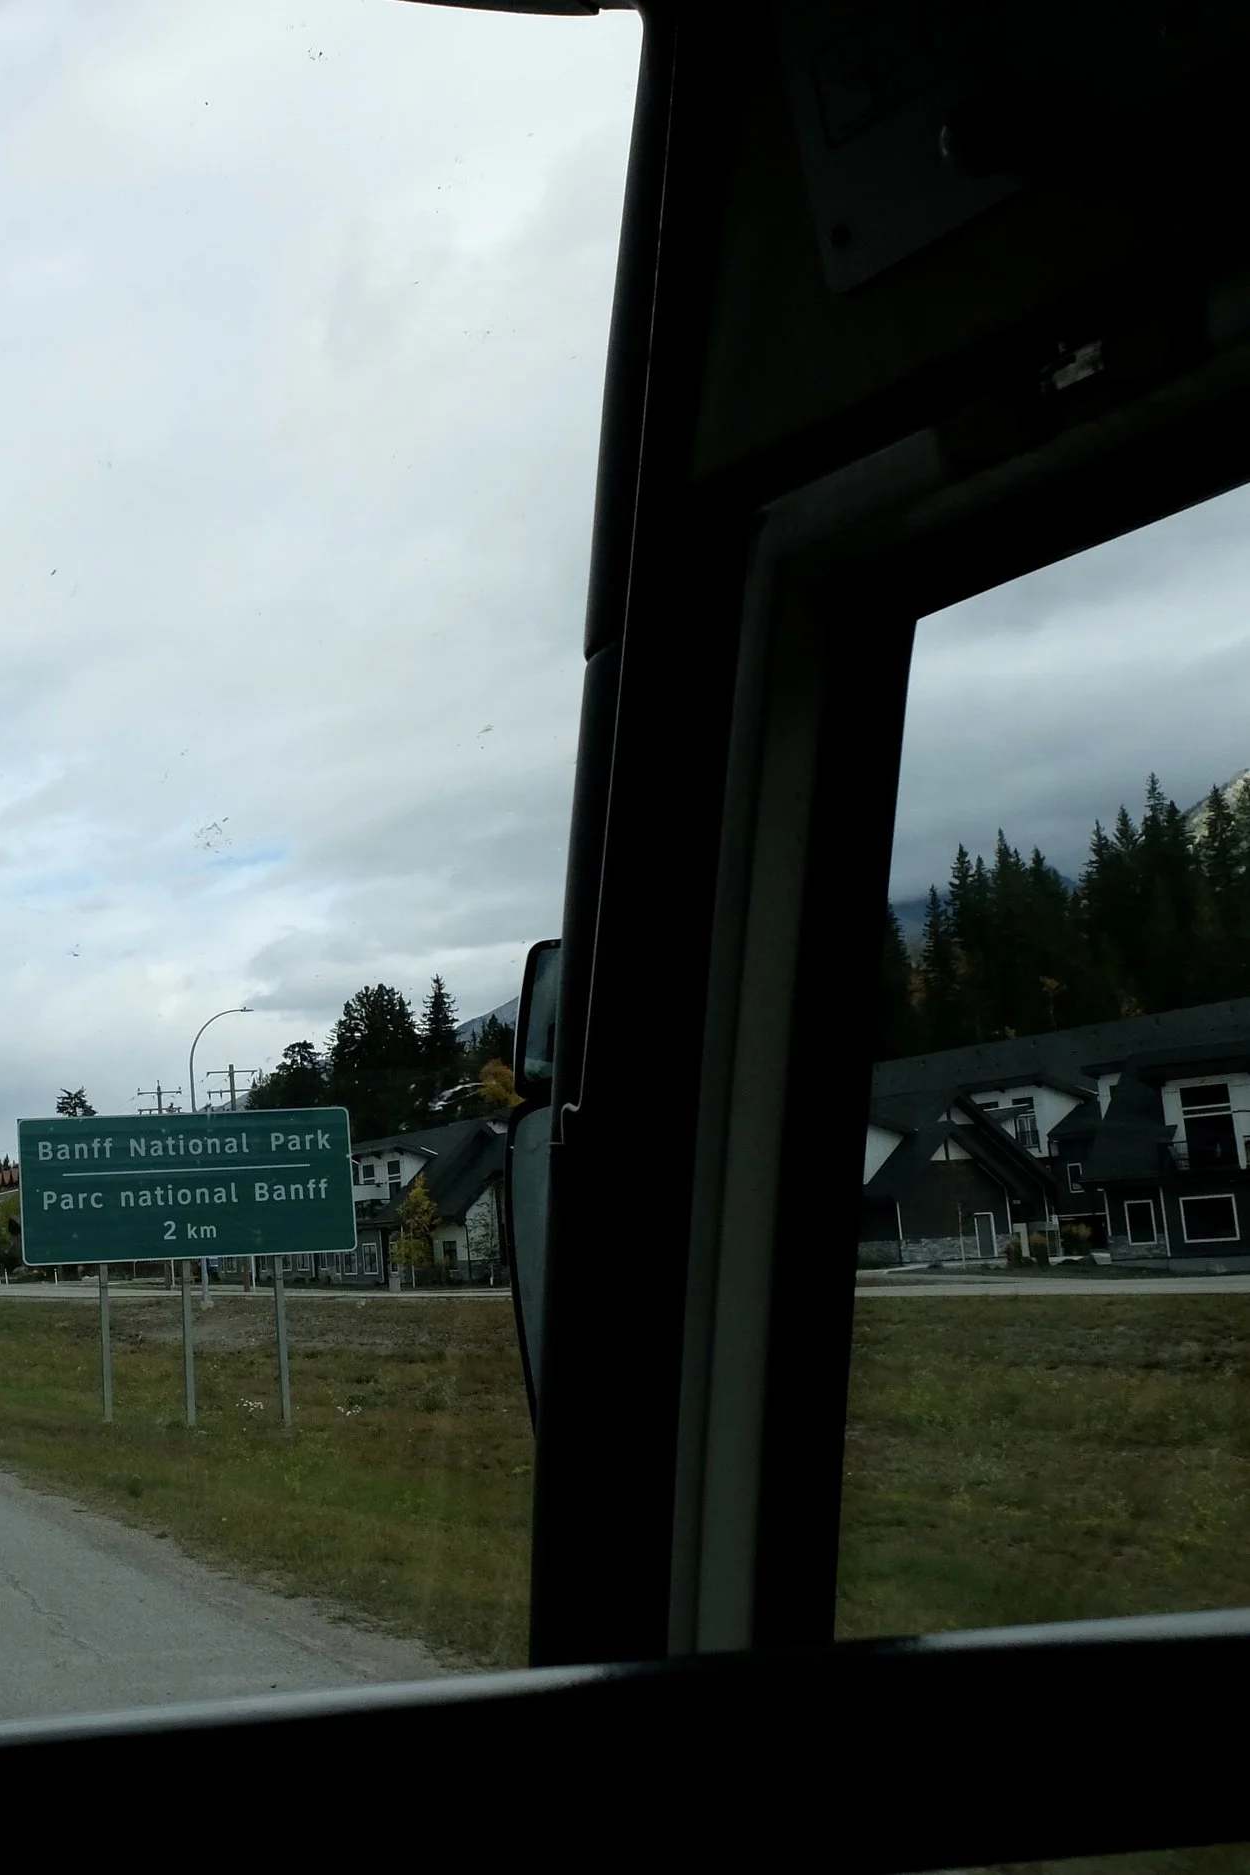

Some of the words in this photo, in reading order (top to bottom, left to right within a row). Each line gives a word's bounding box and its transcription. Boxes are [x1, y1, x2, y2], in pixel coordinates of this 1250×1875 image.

[37, 1137, 113, 1161] Banff
[129, 1132, 250, 1158] National
[270, 1129, 332, 1152] Park
[42, 1190, 104, 1211] Parc
[120, 1182, 239, 1208] national
[254, 1178, 328, 1203] Banff
[163, 1220, 177, 1240] 2
[187, 1222, 217, 1239] km
